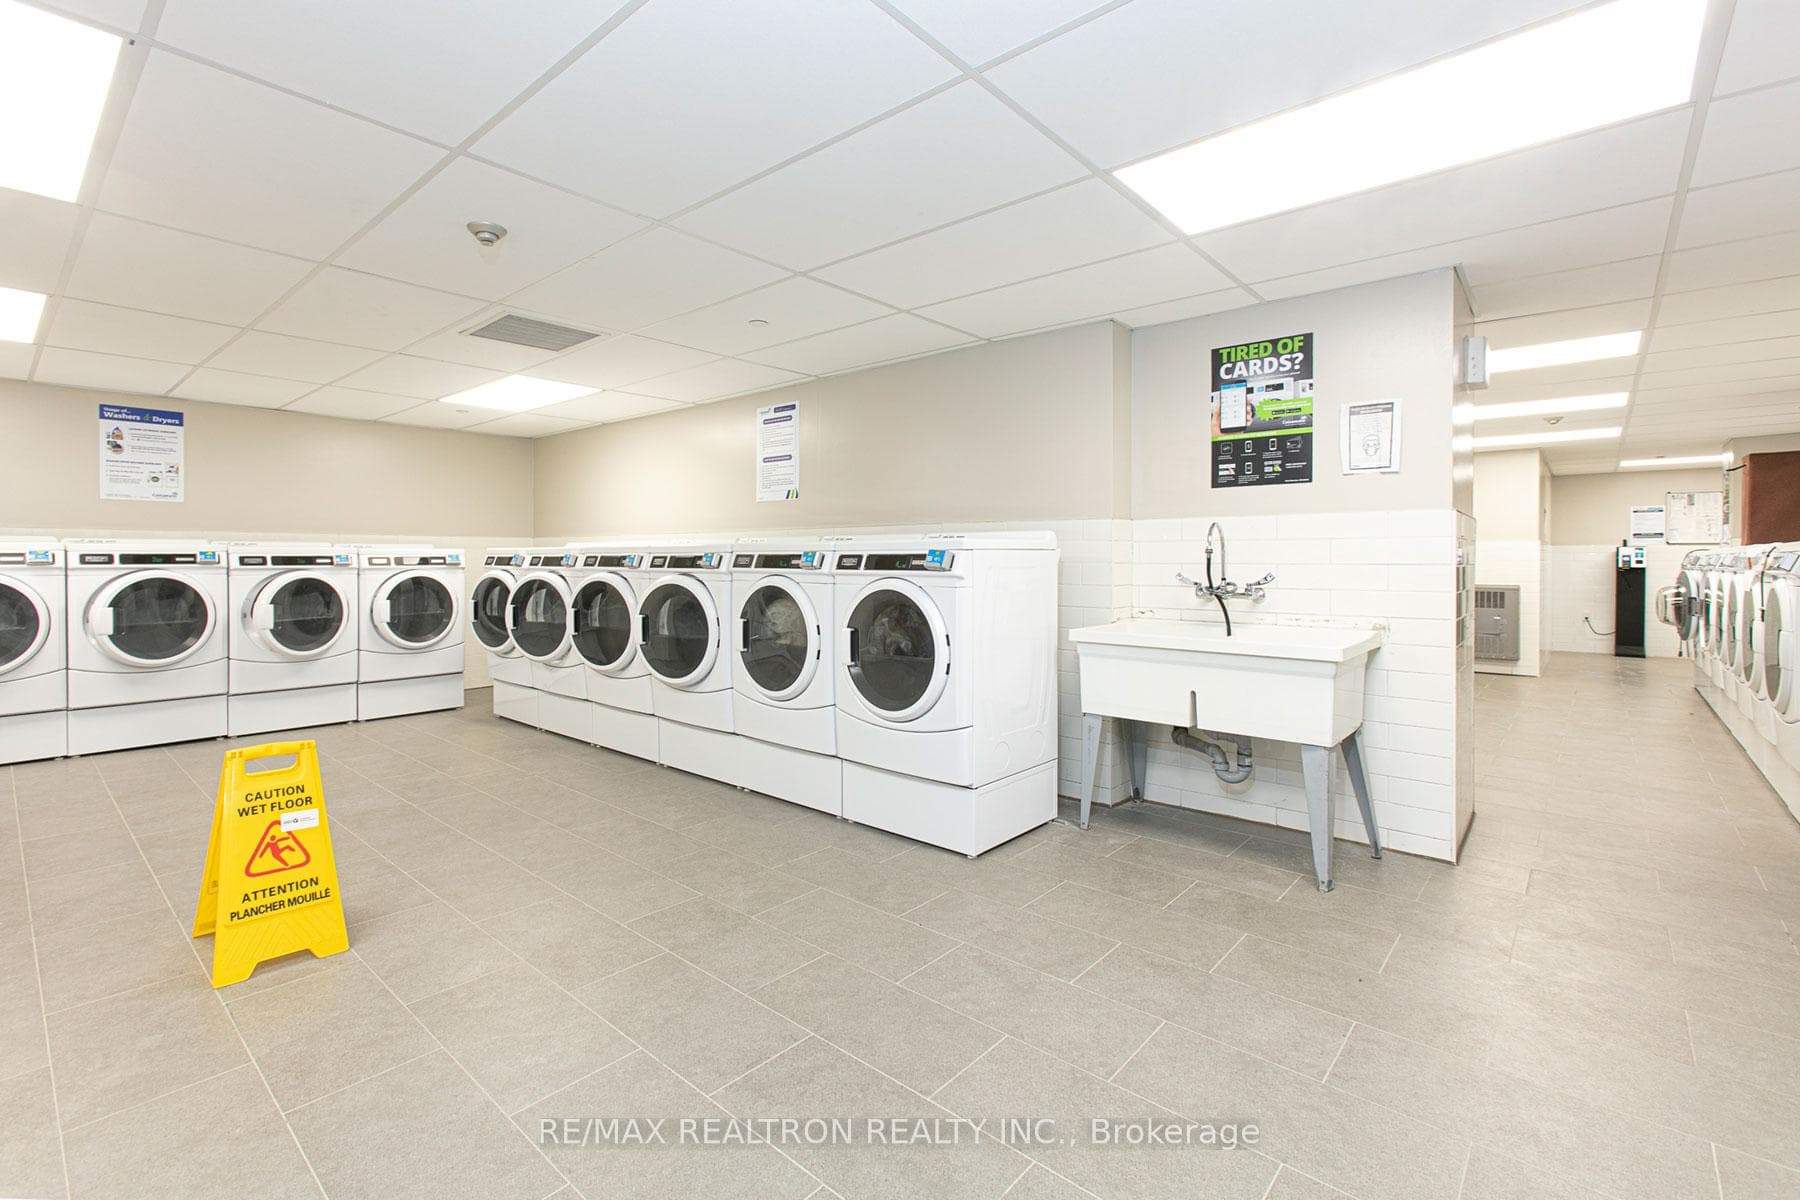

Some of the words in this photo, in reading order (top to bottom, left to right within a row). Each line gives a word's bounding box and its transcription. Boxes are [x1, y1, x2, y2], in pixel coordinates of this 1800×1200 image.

[1219, 341, 1273, 364] TIRED
[1276, 336, 1304, 355] OF
[1219, 352, 1304, 380] CARDS?
[103, 411, 141, 421] Washers
[152, 416, 180, 424] Dryers
[237, 804, 267, 818] WET
[270, 796, 313, 812] FLOOR
[245, 784, 305, 803] CAUTION
[230, 899, 286, 922] PLANCHER
[287, 886, 331, 907] MOUILLÉ
[241, 876, 319, 904] ATTENTION
